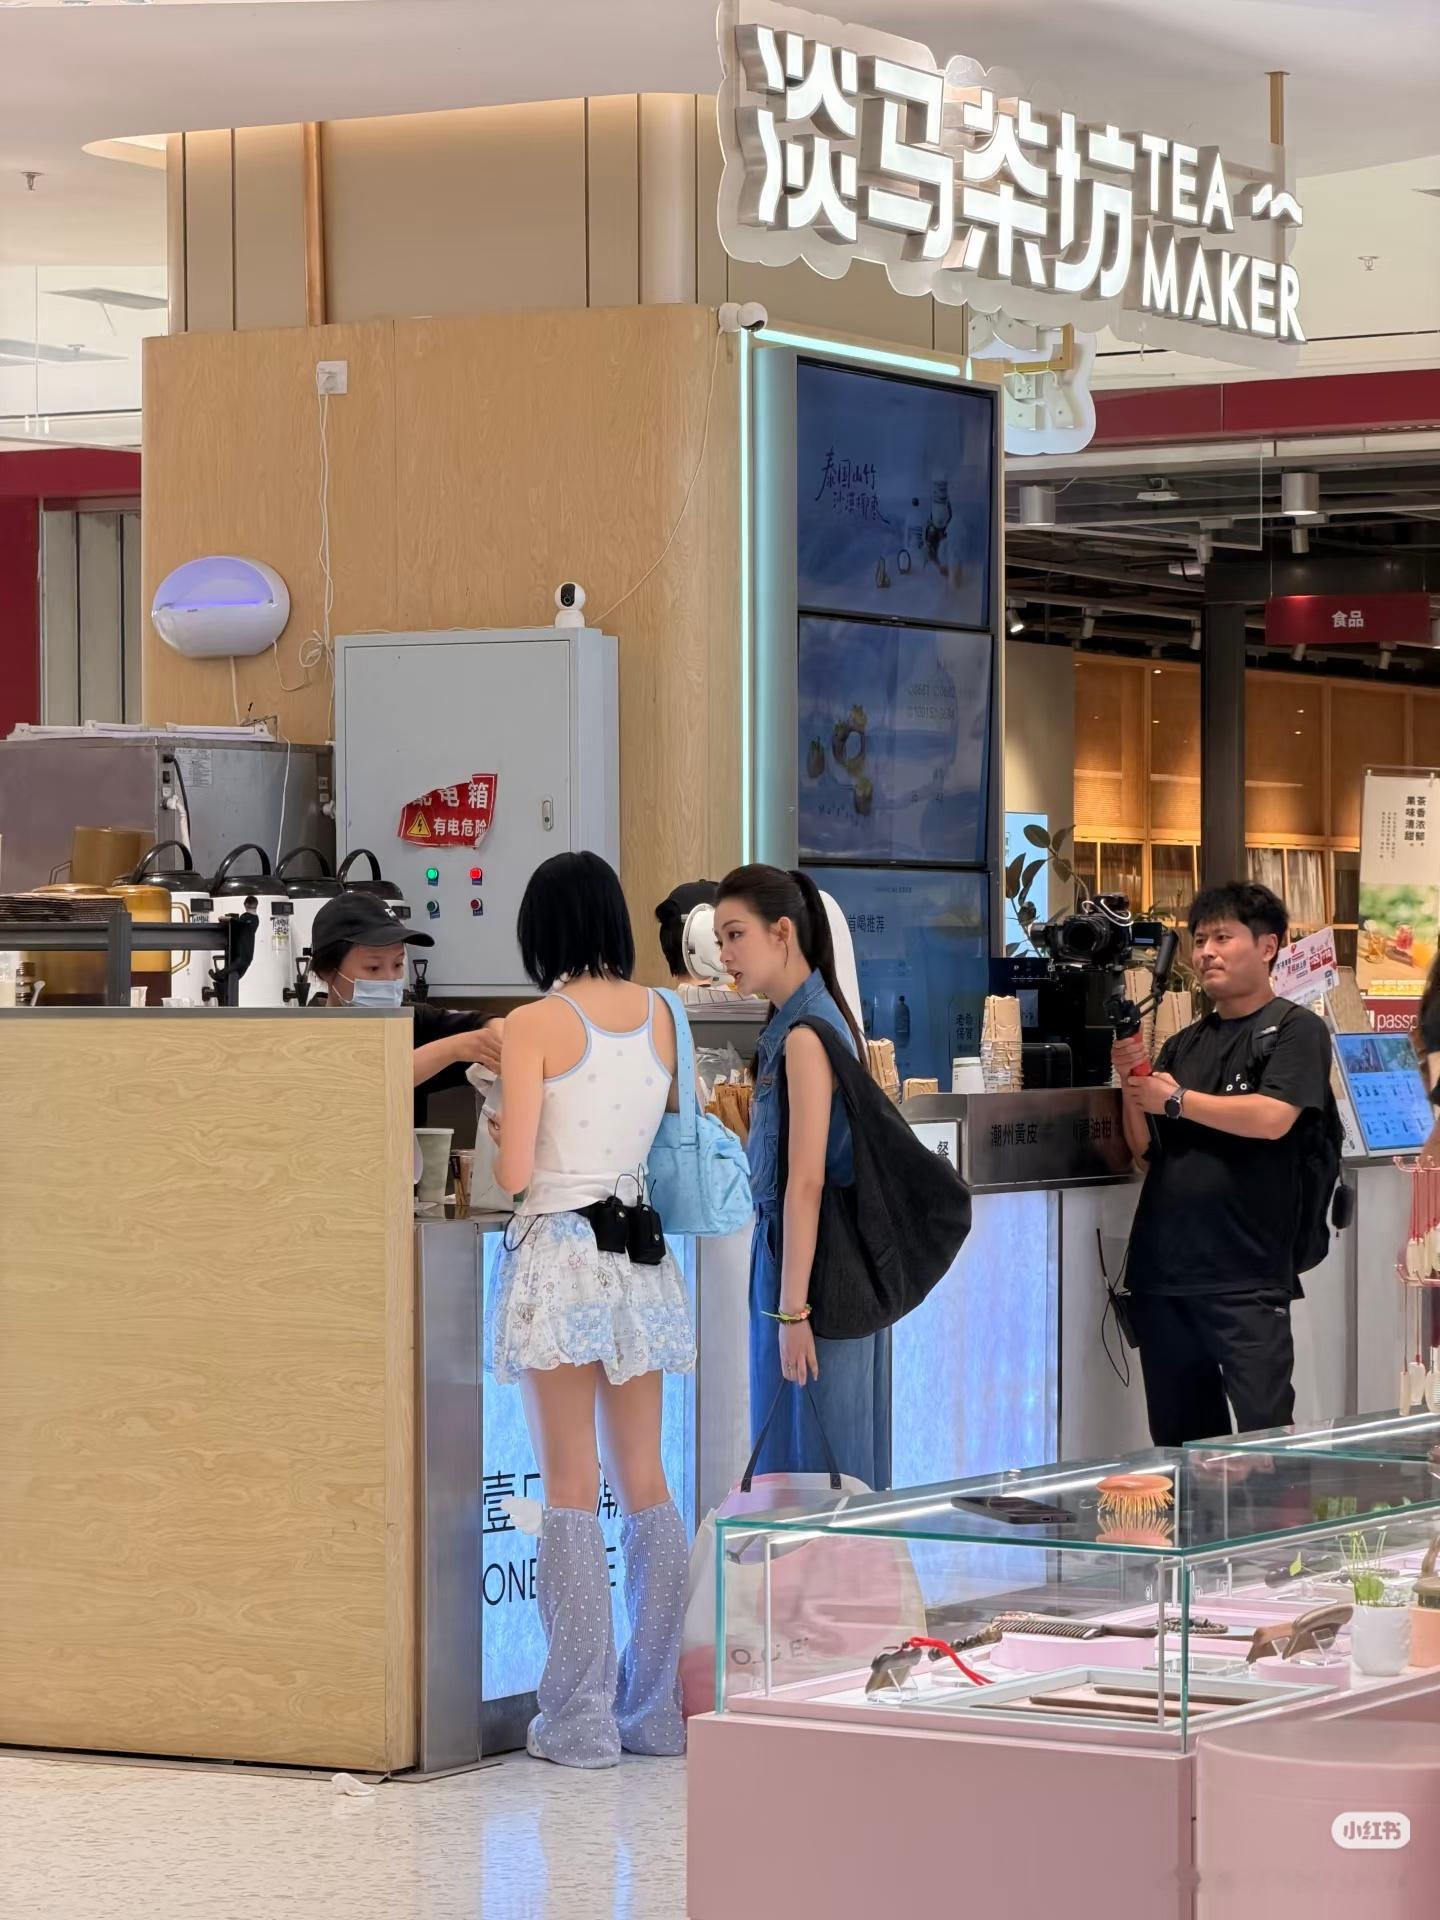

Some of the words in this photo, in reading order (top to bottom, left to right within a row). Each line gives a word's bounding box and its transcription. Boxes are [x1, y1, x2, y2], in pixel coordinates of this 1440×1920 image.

[740, 24, 1135, 299] 淡马茶坊
[1138, 131, 1235, 233] TEA
[1140, 226, 1307, 344] MAKER
[1331, 610, 1364, 628] 食品
[433, 817, 488, 837] 有电危险
